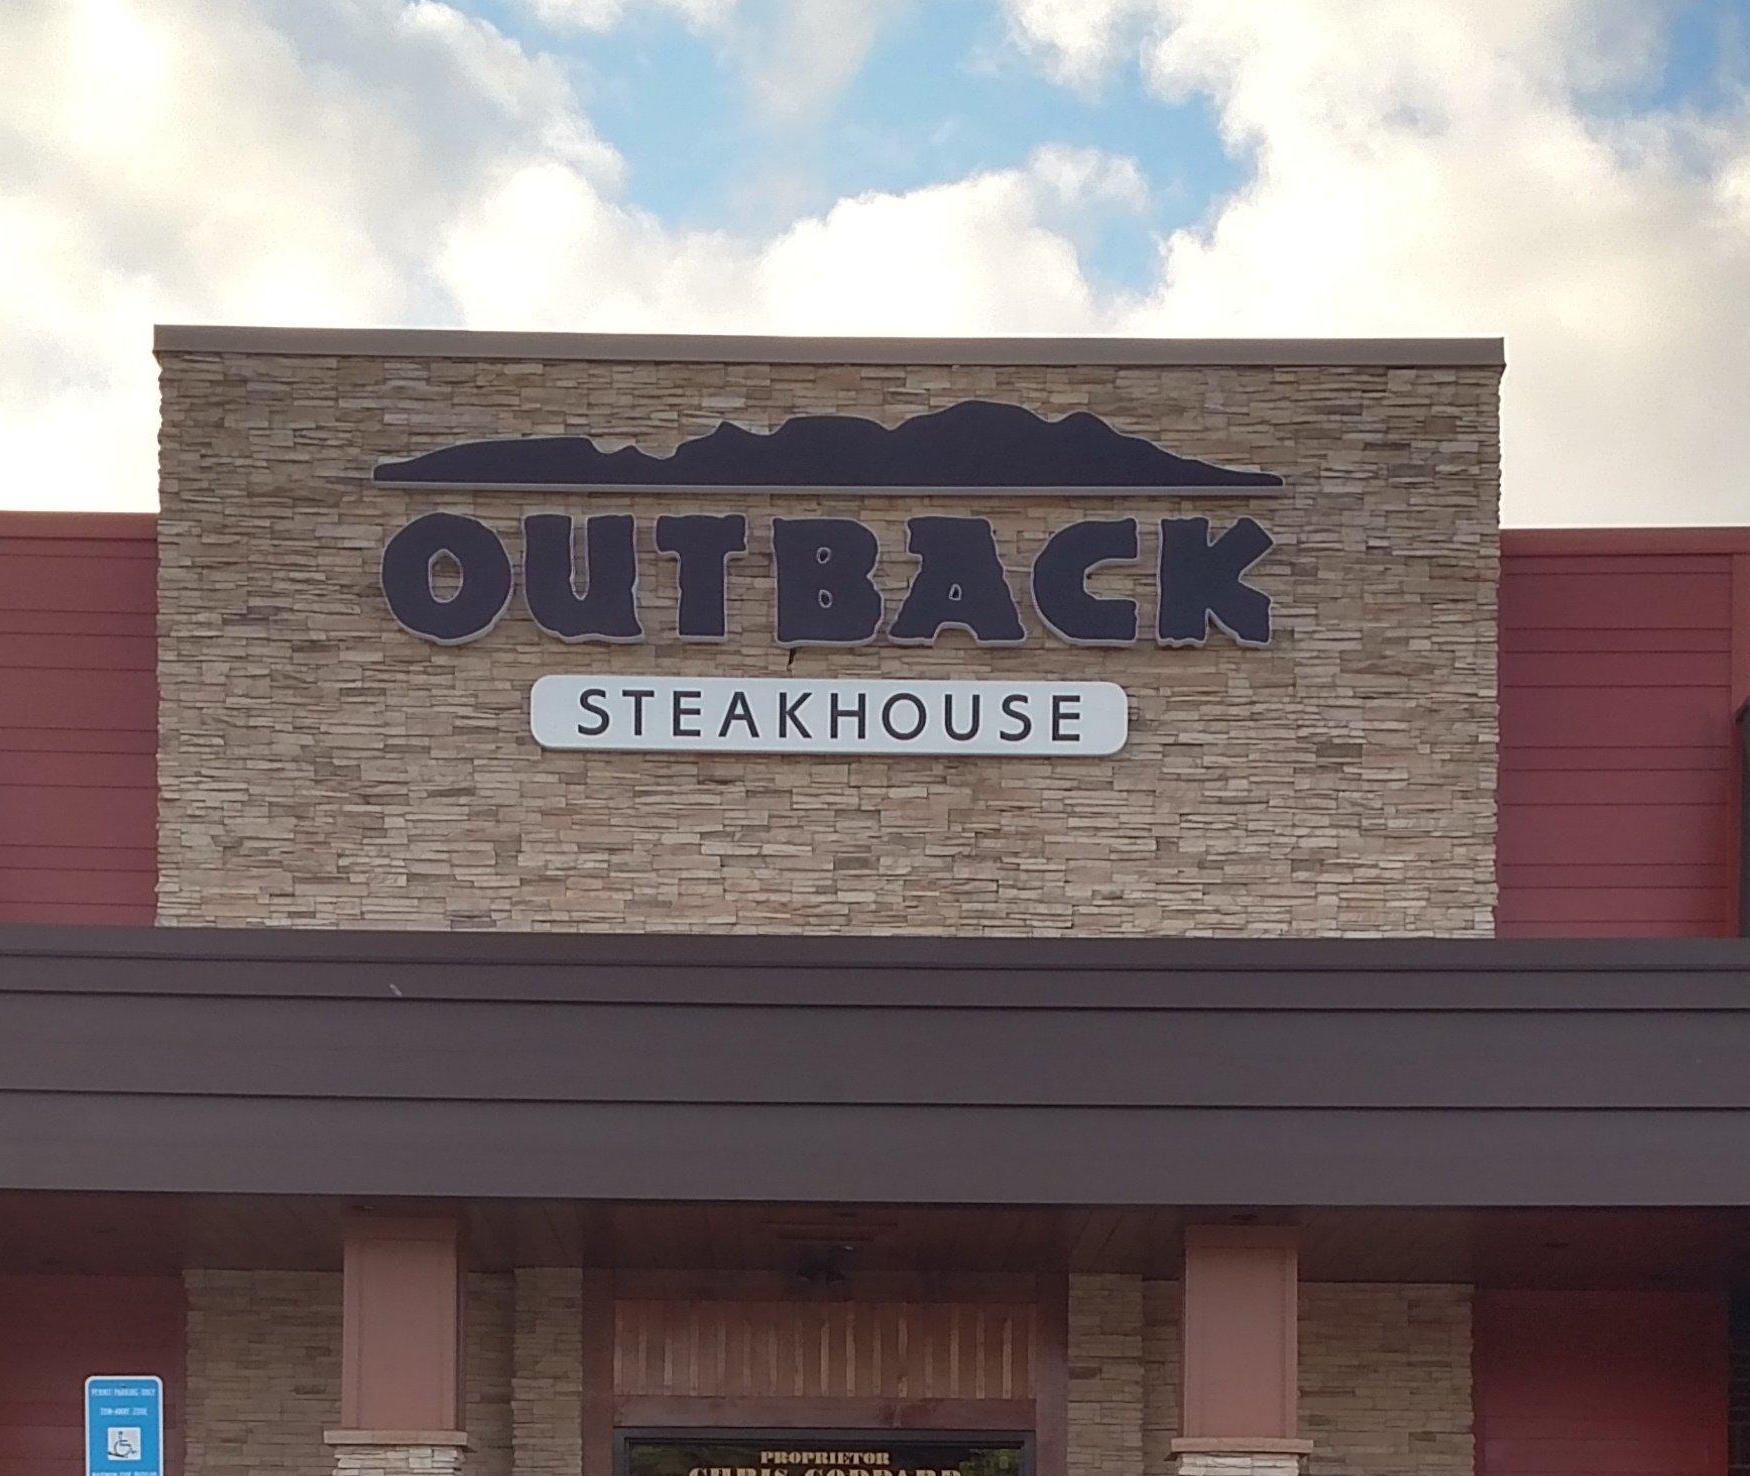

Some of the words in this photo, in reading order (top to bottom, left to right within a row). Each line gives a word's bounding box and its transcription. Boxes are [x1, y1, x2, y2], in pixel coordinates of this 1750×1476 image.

[380, 511, 1274, 648] OUTBACK
[576, 688, 1083, 743] STEAKHOUSE
[760, 1451, 890, 1465] PROPRIETOR
